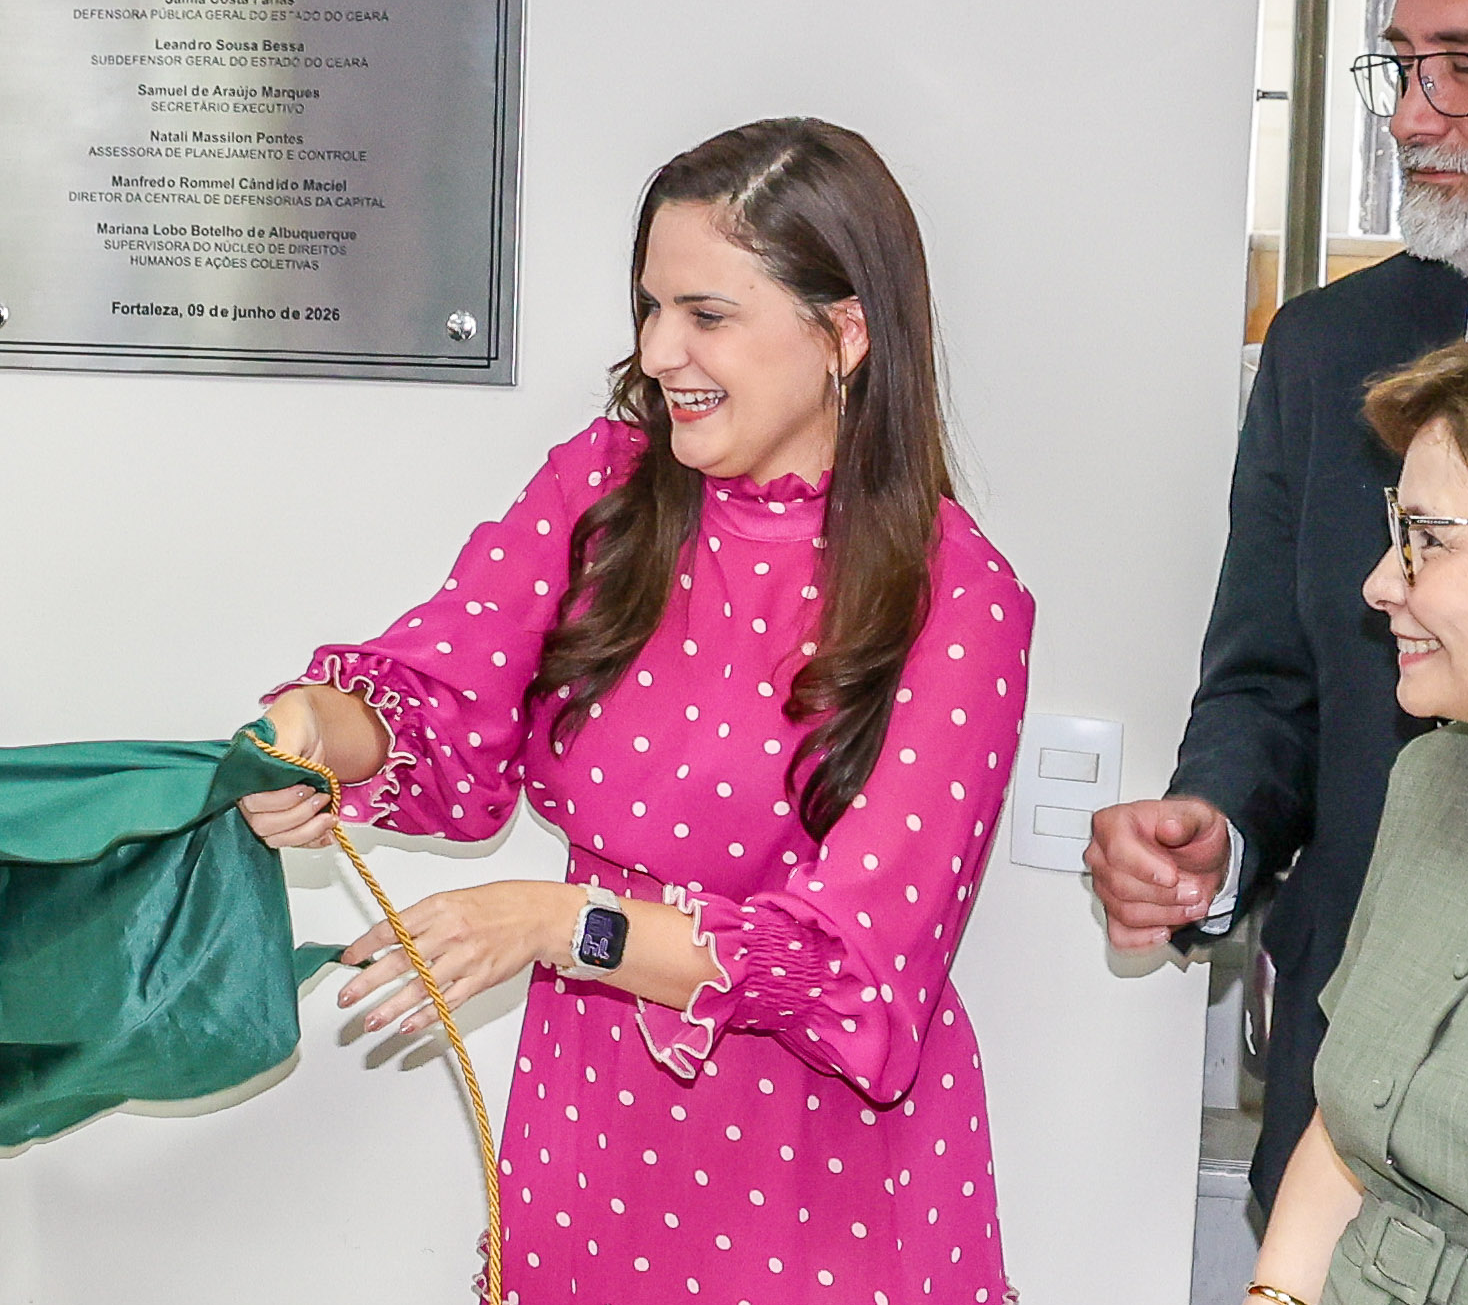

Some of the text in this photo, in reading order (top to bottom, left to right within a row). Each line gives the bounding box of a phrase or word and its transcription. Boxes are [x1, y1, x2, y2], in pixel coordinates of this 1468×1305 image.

[73, 9, 147, 20] DEFENSORA
[151, 7, 202, 20] PÚBLICA
[205, 10, 245, 21] GERAL
[249, 10, 267, 21] DO
[324, 11, 342, 22] DO
[155, 39, 304, 52] Leandro Sousa Bessa
[91, 55, 182, 66] SUBDEFENSOR
[186, 56, 226, 66] GERAL
[230, 56, 248, 67] DO
[251, 57, 301, 67] ESTADO
[305, 57, 322, 68] DO
[138, 84, 320, 100] Samuel de Araújo Marques
[151, 99, 304, 114] SECRETÁRIO EXECUTIVO
[151, 130, 303, 144] Natali Massilon Pontes
[89, 147, 367, 161] ASSESSORA DE PLANEJAMENTO E CONTROLE
[112, 176, 347, 192] Manfredo Rommel Cândido Maciel
[69, 191, 385, 208] DIRETOR DA CENTRAL DE DEFENSORIAS DA CAPITAL
[97, 223, 357, 241] Mariana Lobo Botelho de Albuquerque
[104, 240, 346, 255] SUPERVISORA DO NÚCLEO DE DIREITOS
[130, 255, 319, 270] HUMANOS E AÇÕES COLETIVAS
[112, 302, 340, 321] Fortaleza, 09 de junho de 2026
